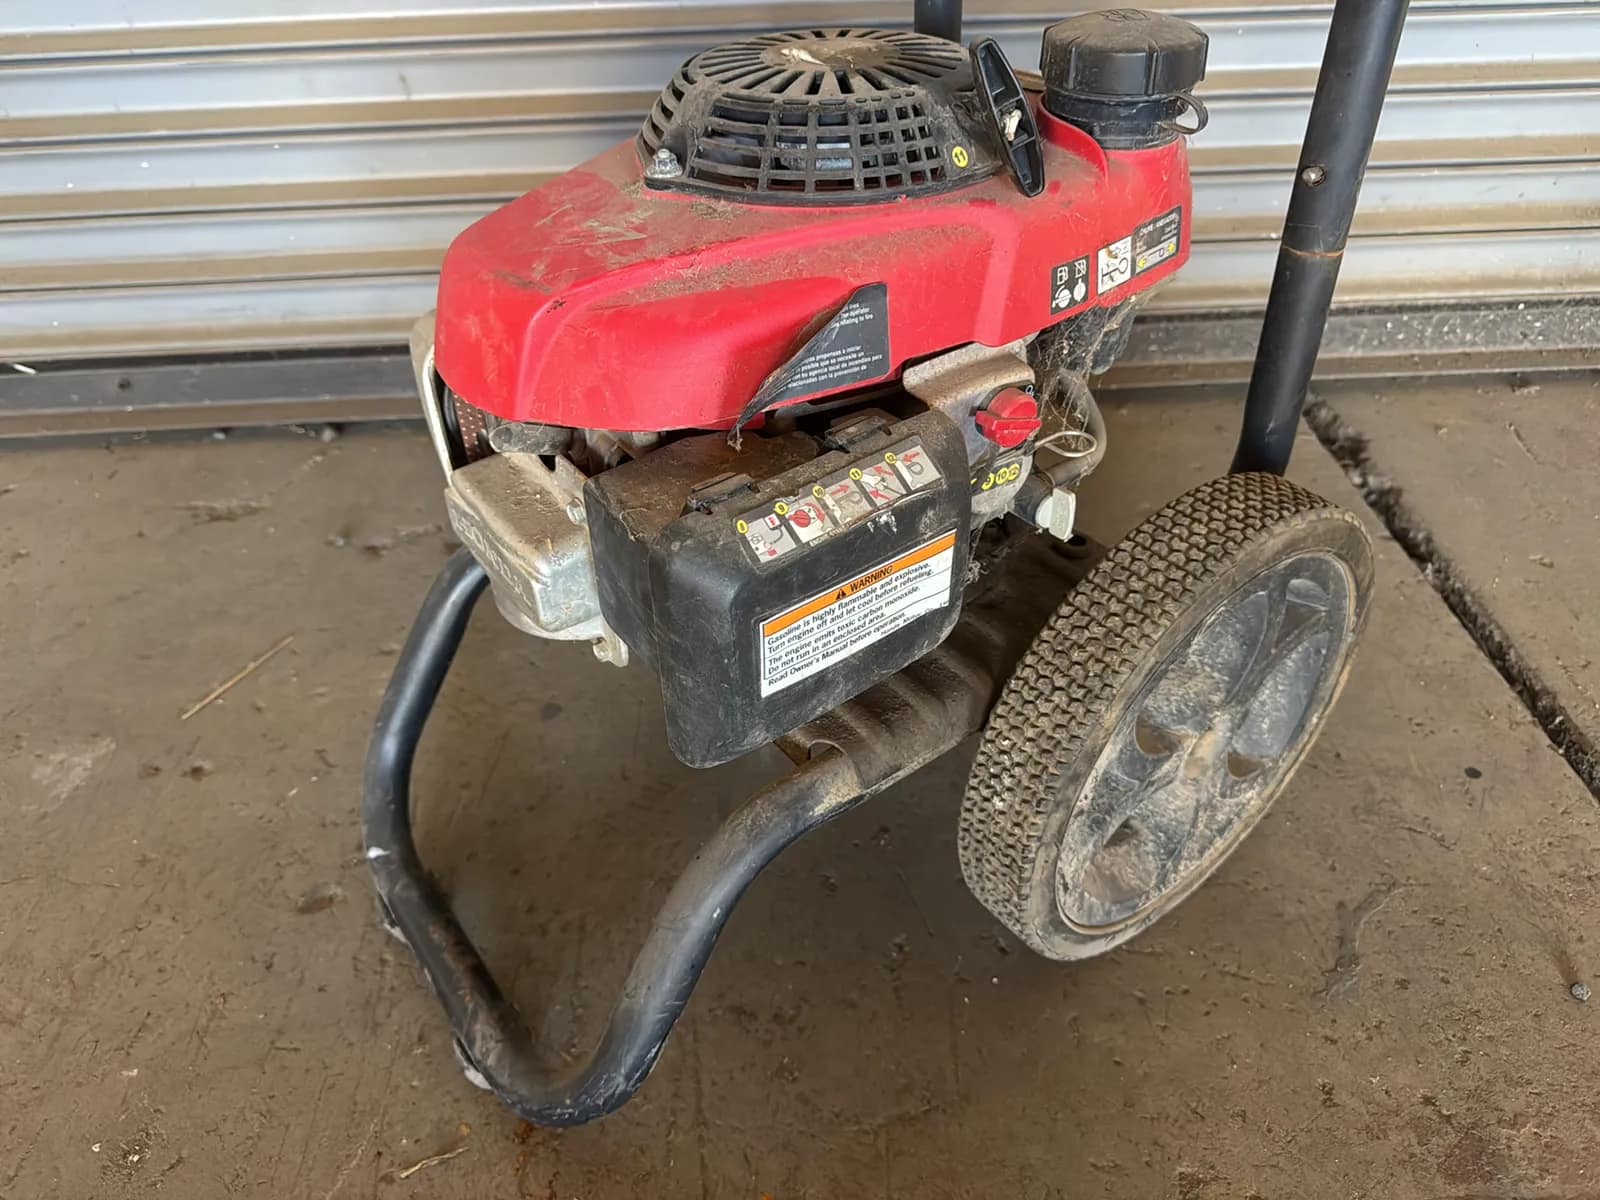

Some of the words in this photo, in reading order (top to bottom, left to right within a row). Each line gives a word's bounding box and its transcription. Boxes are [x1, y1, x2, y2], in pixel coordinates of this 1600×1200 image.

[953, 151, 967, 163] 11
[767, 623, 802, 646] Gasoline
[803, 619, 810, 628] is
[812, 606, 836, 623] highly
[838, 585, 877, 611] flammable
[879, 577, 893, 591] and
[894, 562, 930, 583] explosive.
[767, 641, 786, 655] Turn
[787, 626, 814, 643] engine
[816, 619, 828, 630] off
[829, 611, 844, 624] and
[845, 605, 856, 616] let
[857, 596, 874, 610] cool
[875, 584, 898, 603] before
[899, 568, 934, 588] refueling.
[849, 564, 893, 593] WARNING
[768, 654, 783, 667] The
[784, 639, 812, 657] engine
[814, 629, 836, 644] emits
[837, 618, 856, 633] toxic
[857, 603, 883, 622] carbon
[884, 585, 921, 608] monoxide.
[768, 665, 780, 675] Do
[780, 656, 794, 668] not
[796, 650, 811, 661] run
[812, 644, 820, 654] in
[821, 639, 832, 650] an
[833, 621, 867, 643] enclosed
[868, 612, 886, 626] area.
[768, 670, 788, 687] Read
[789, 657, 820, 676] Owner's
[821, 642, 849, 661] Manual
[849, 630, 872, 647] before
[873, 612, 906, 634] operation.
